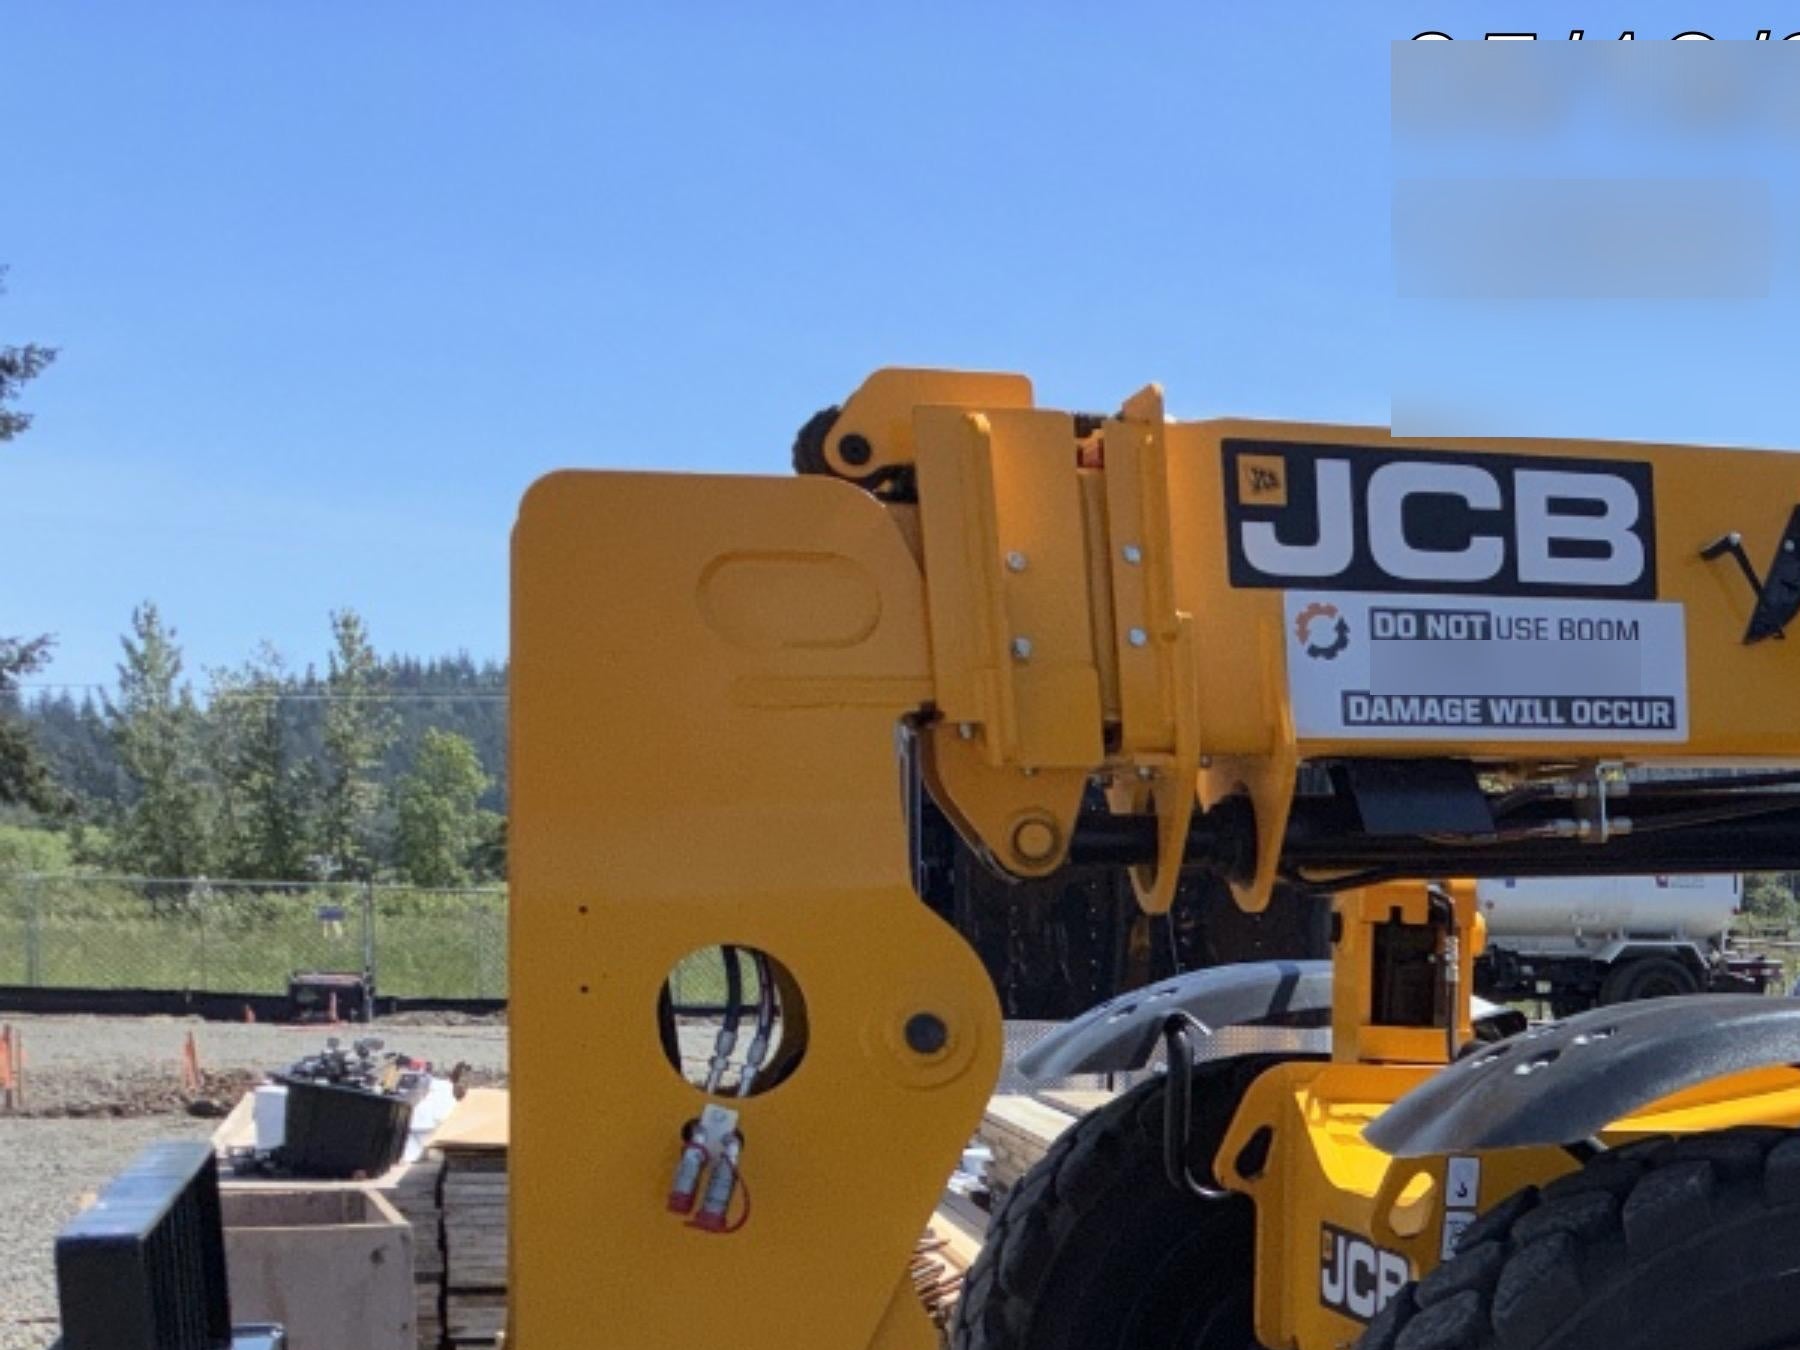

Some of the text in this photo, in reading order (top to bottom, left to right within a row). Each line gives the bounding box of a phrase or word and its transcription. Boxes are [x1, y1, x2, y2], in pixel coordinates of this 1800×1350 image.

[1241, 458, 1645, 586] JCB
[1373, 611, 1639, 640] DO NOT USE BOOM
[1347, 695, 1672, 726] DAMAGE WILL OCCUR
